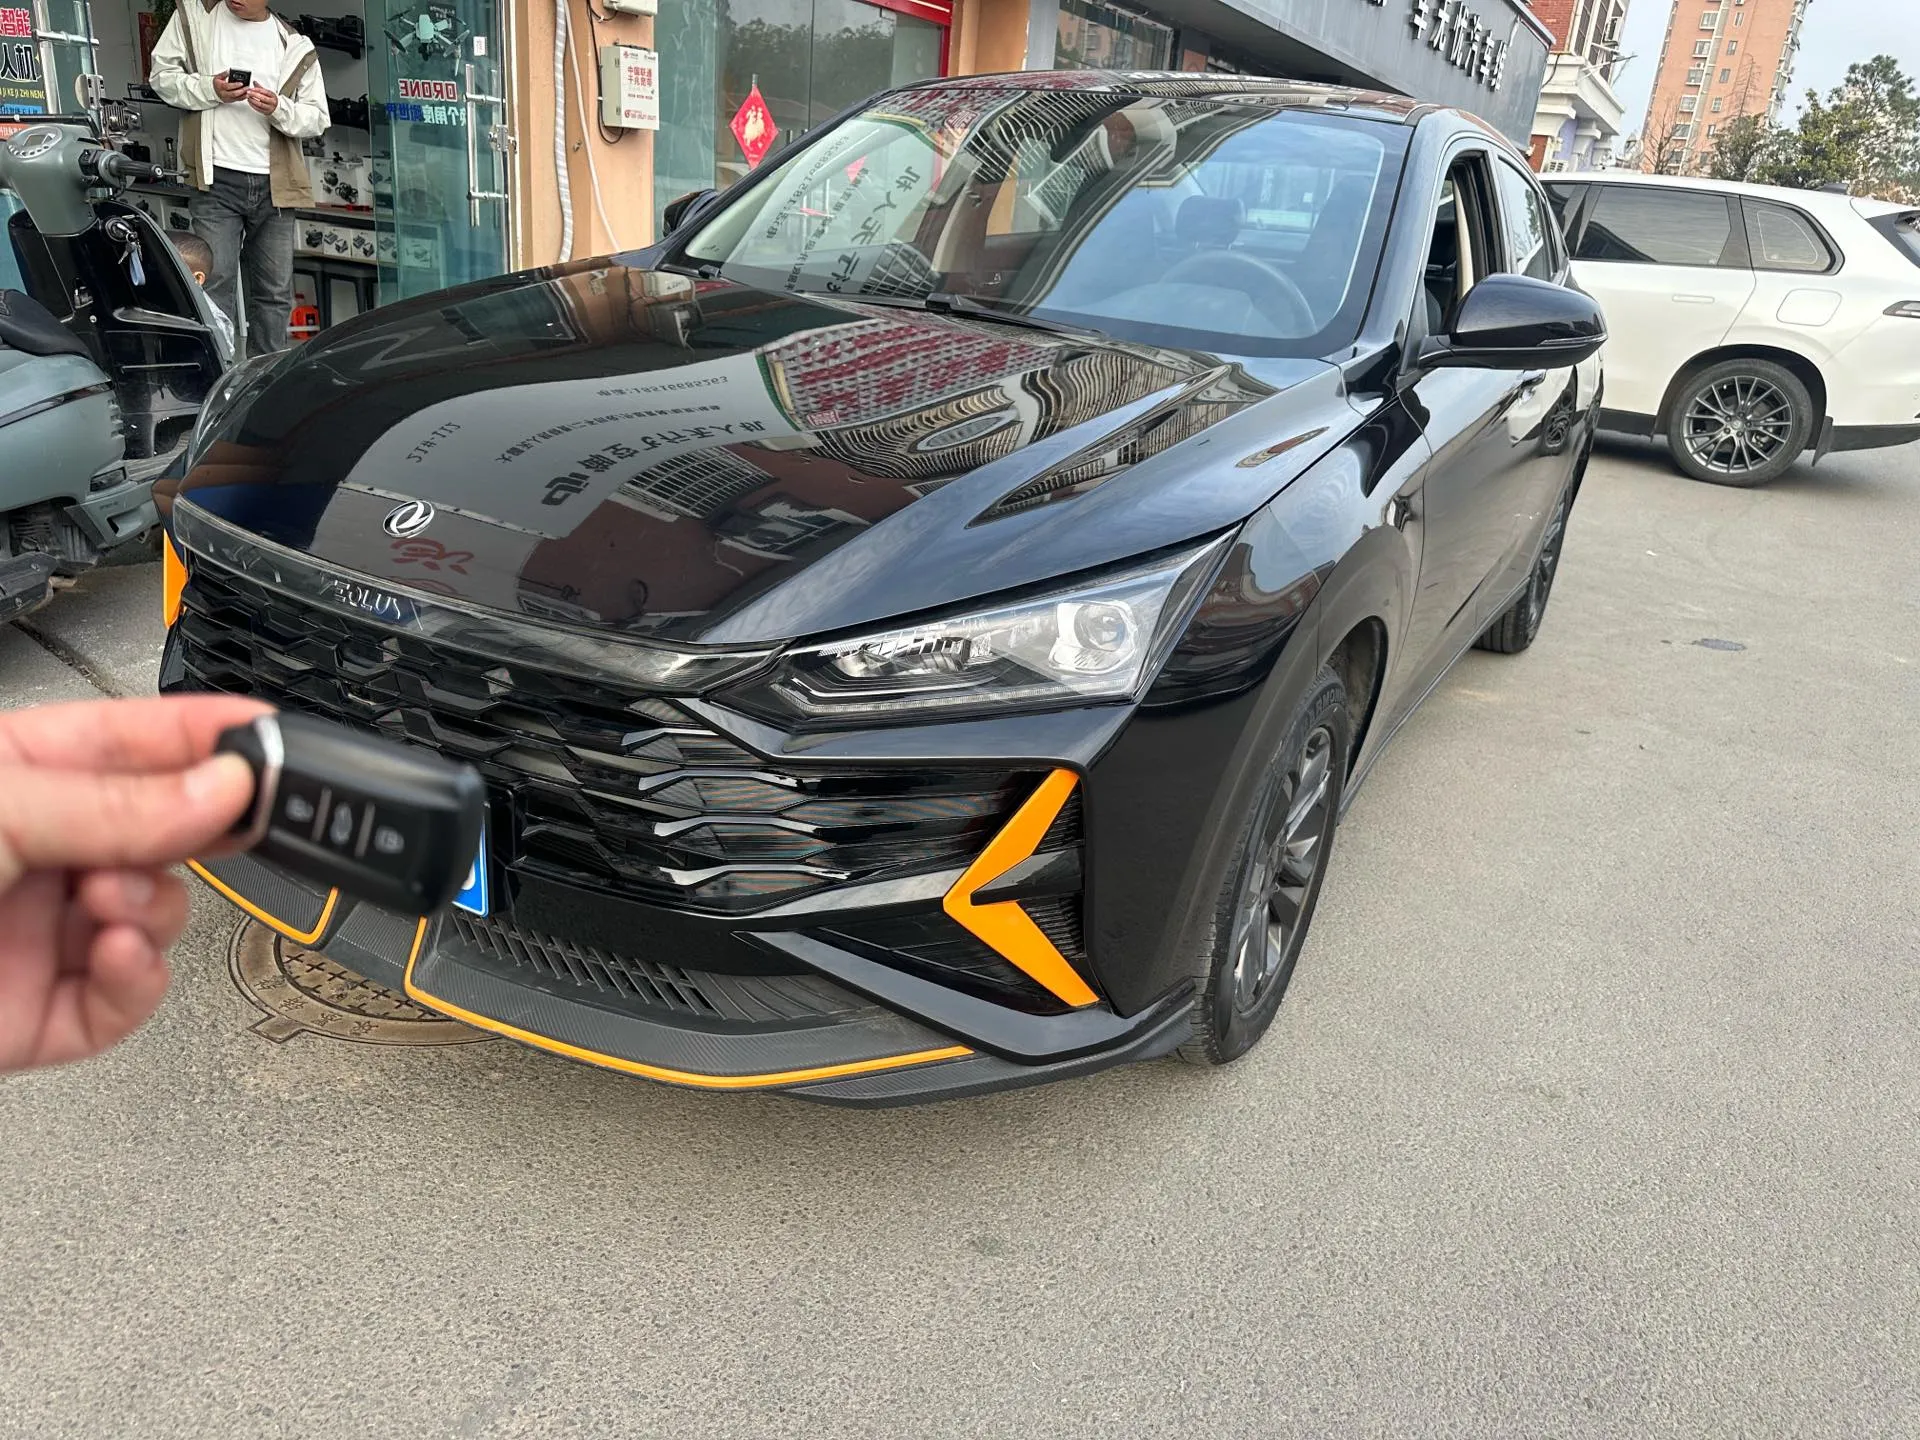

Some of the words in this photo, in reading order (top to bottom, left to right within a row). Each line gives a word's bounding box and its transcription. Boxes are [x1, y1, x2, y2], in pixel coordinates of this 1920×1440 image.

[0, 8, 32, 37] 智能
[628, 65, 652, 78] 中国联通
